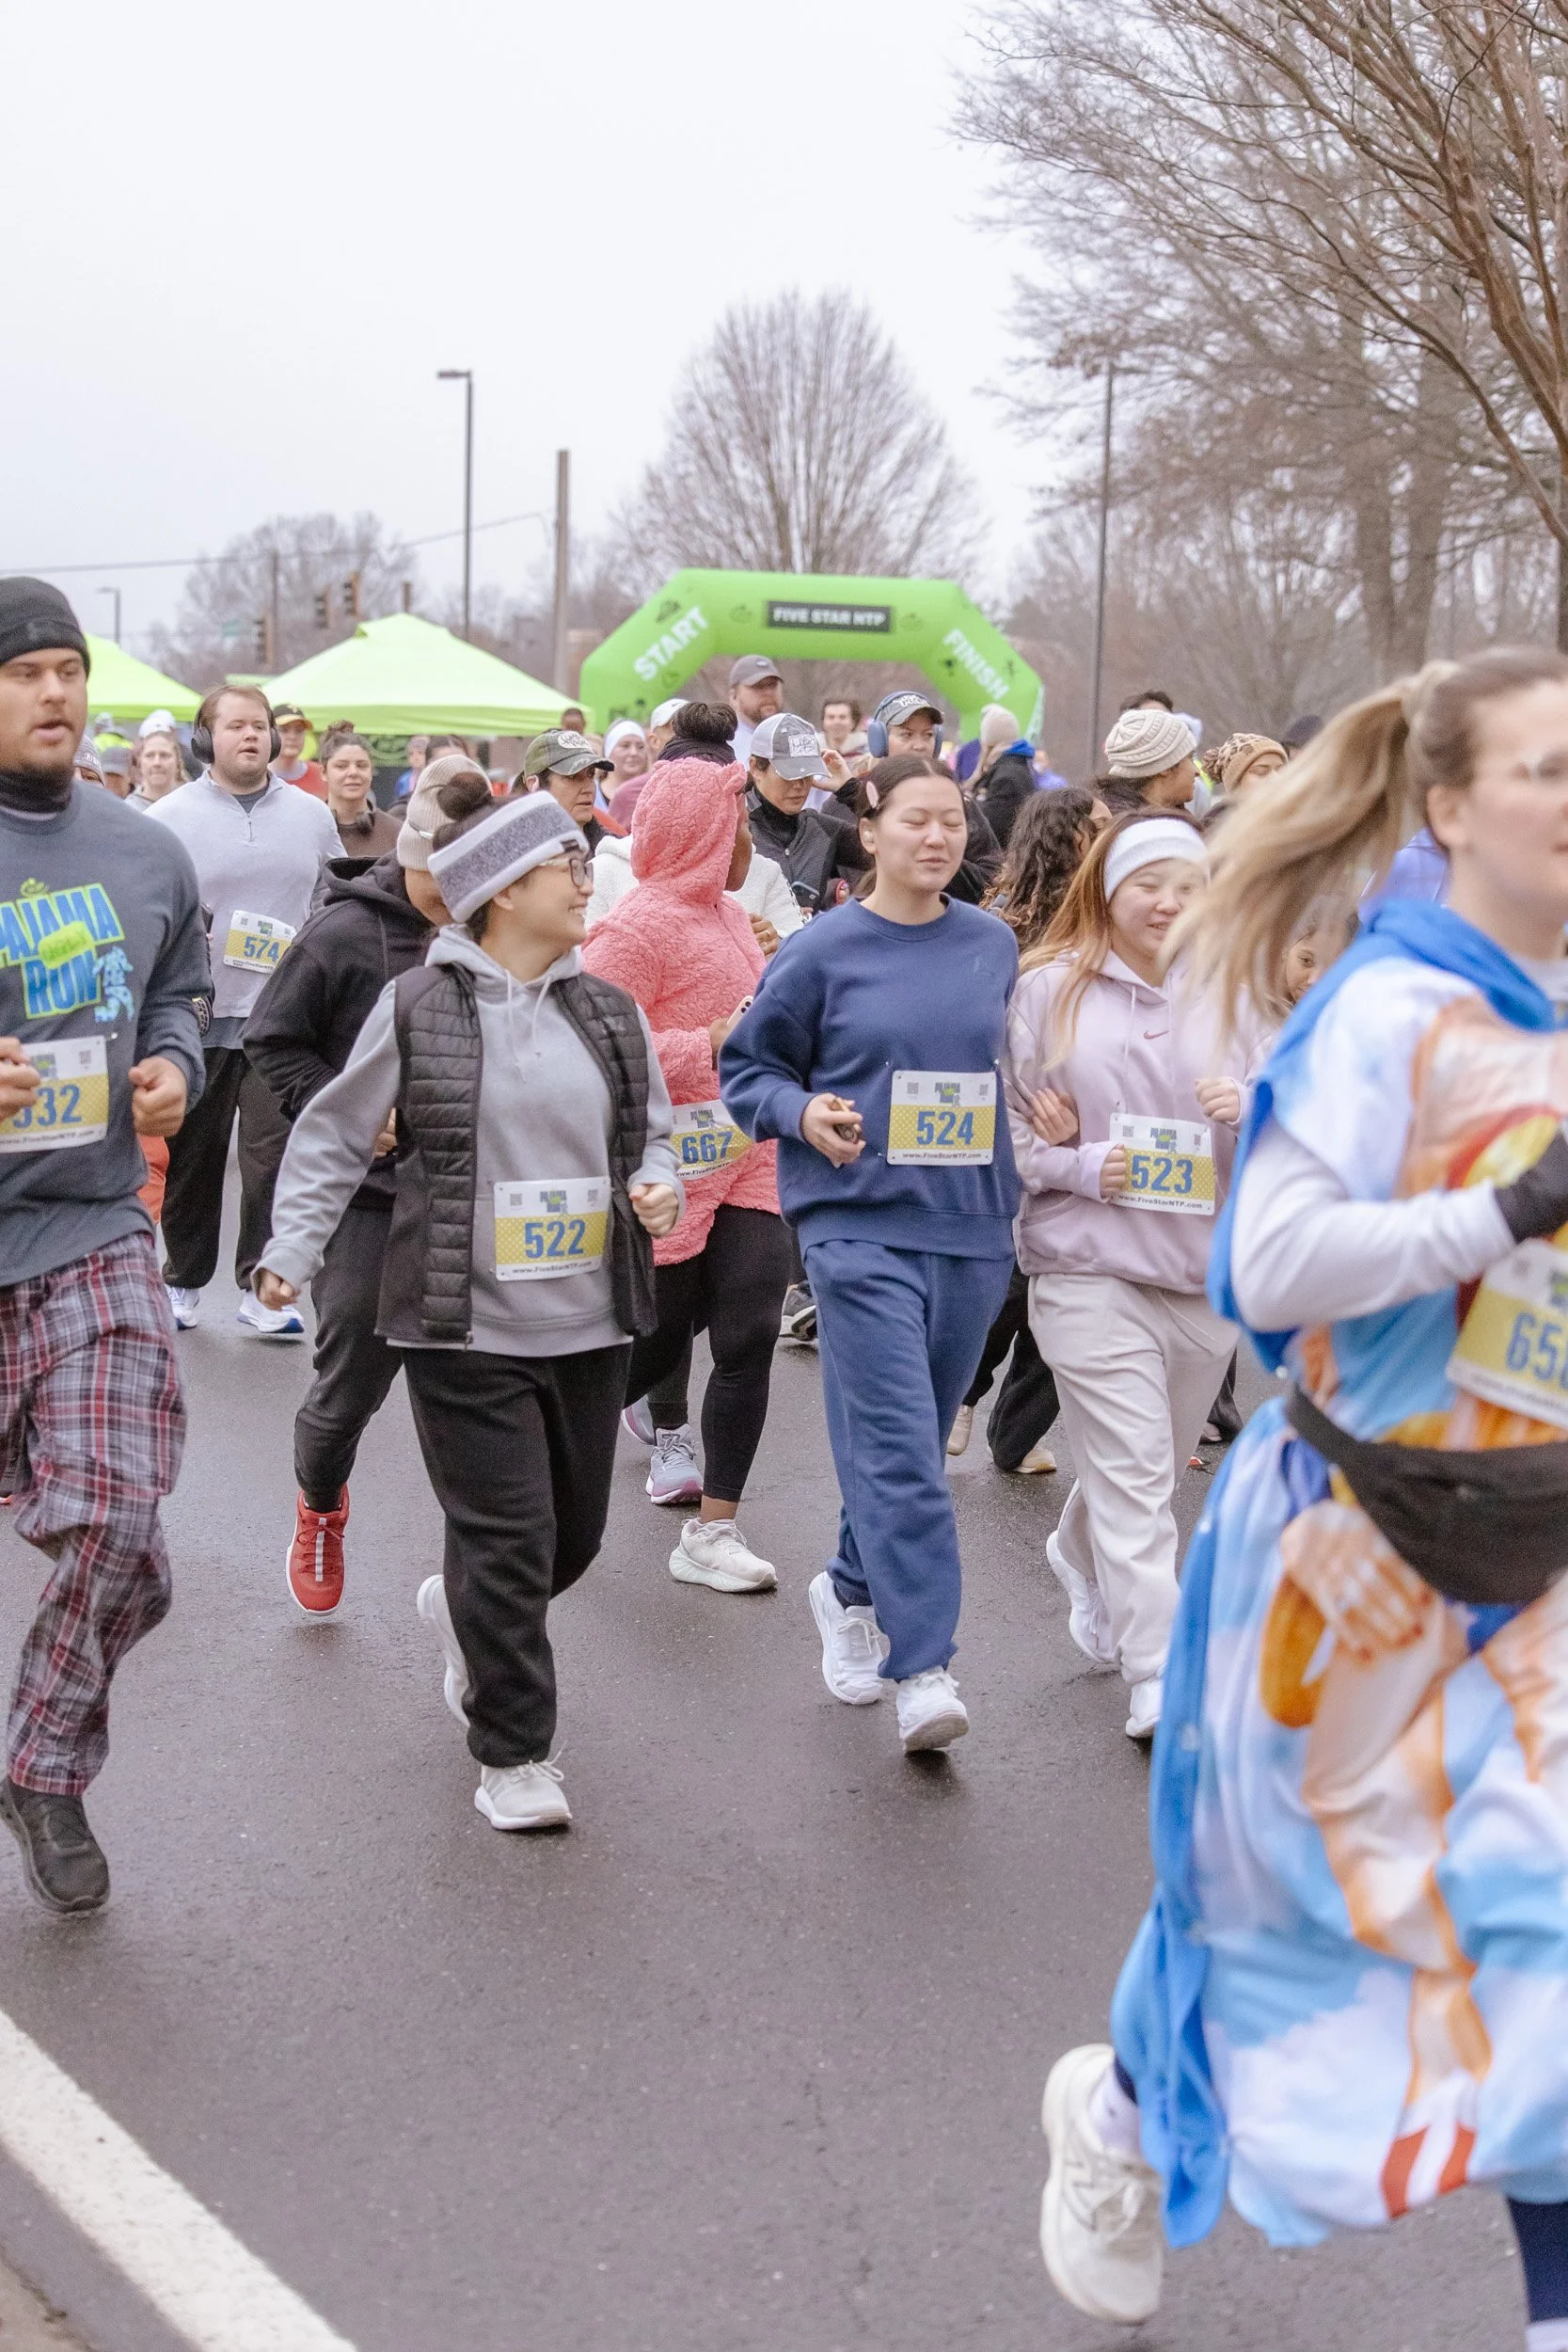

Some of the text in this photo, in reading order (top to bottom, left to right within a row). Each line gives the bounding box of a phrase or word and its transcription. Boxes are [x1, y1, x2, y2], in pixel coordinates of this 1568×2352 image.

[773, 607, 809, 623] FIVE
[811, 609, 851, 626] STAR
[632, 606, 708, 681] START
[942, 628, 1009, 701] FINISH
[0, 885, 122, 965] AJAMA
[244, 936, 279, 961] 574
[24, 950, 98, 1016] RUN
[682, 1131, 733, 1164] 667
[916, 1111, 974, 1146] 524
[1131, 1154, 1194, 1194] 523
[1117, 1195, 1204, 1210] www.FiveStarNTP.com
[524, 1219, 586, 1259] 522
